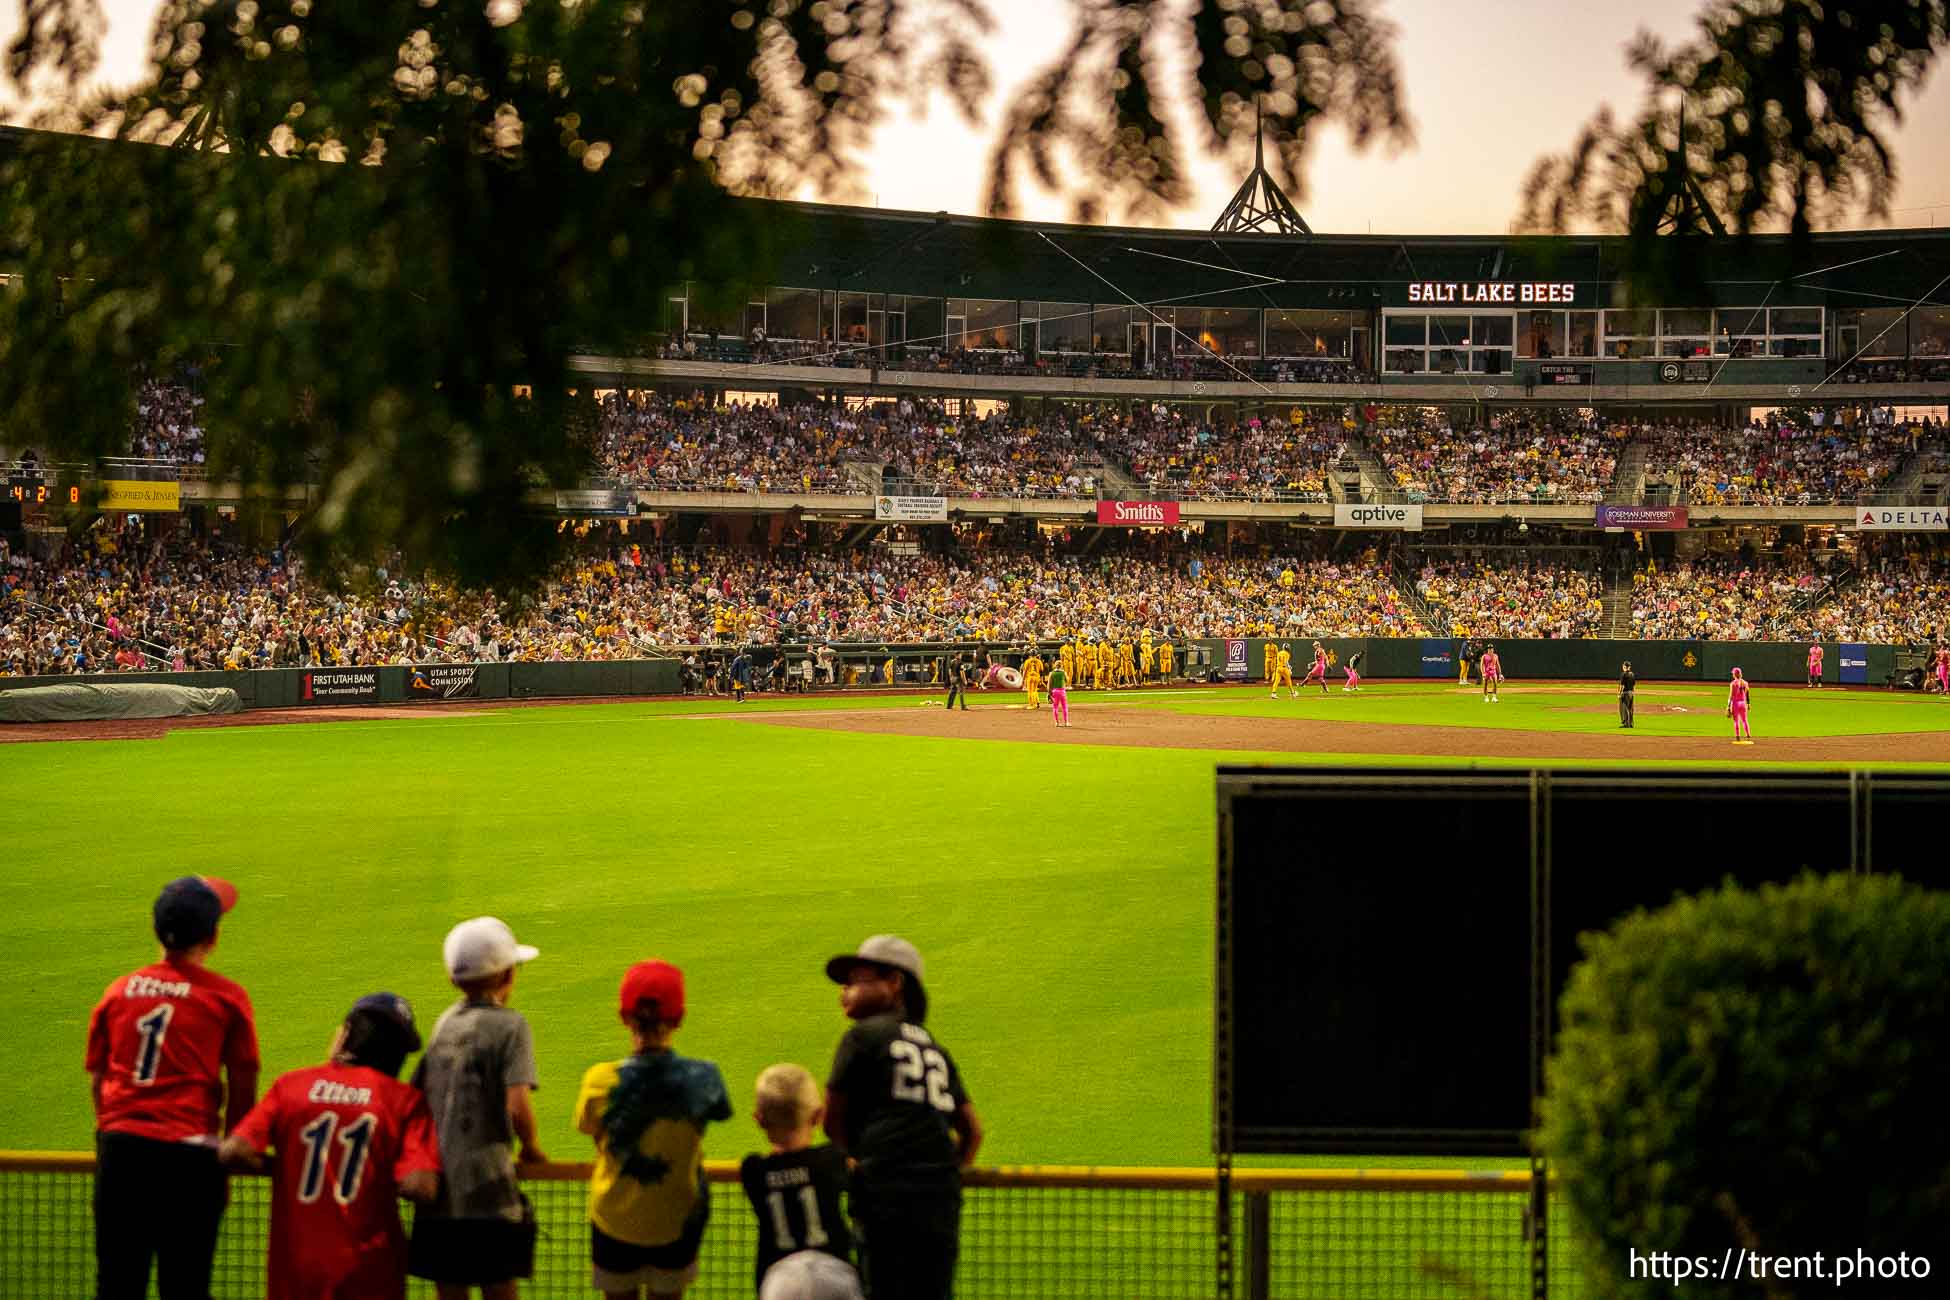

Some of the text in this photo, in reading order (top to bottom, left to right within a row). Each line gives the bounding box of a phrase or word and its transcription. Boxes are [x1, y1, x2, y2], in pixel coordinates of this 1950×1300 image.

[1408, 283, 1575, 302] SALT LAKE BEES
[14, 486, 22, 501] 4
[37, 486, 46, 502] 2
[70, 486, 79, 503] 8
[1115, 501, 1164, 520] Smith's
[1351, 505, 1405, 525] aptive
[1881, 511, 1944, 524] DELTA
[313, 674, 375, 685] FIRST UTAH BANK
[430, 668, 474, 677] UTAH SPORTS
[430, 677, 473, 686] COMMISSION
[132, 1002, 175, 1087] 1
[889, 1039, 956, 1113] 22
[298, 1109, 378, 1205] 11
[767, 1185, 828, 1248] 11
